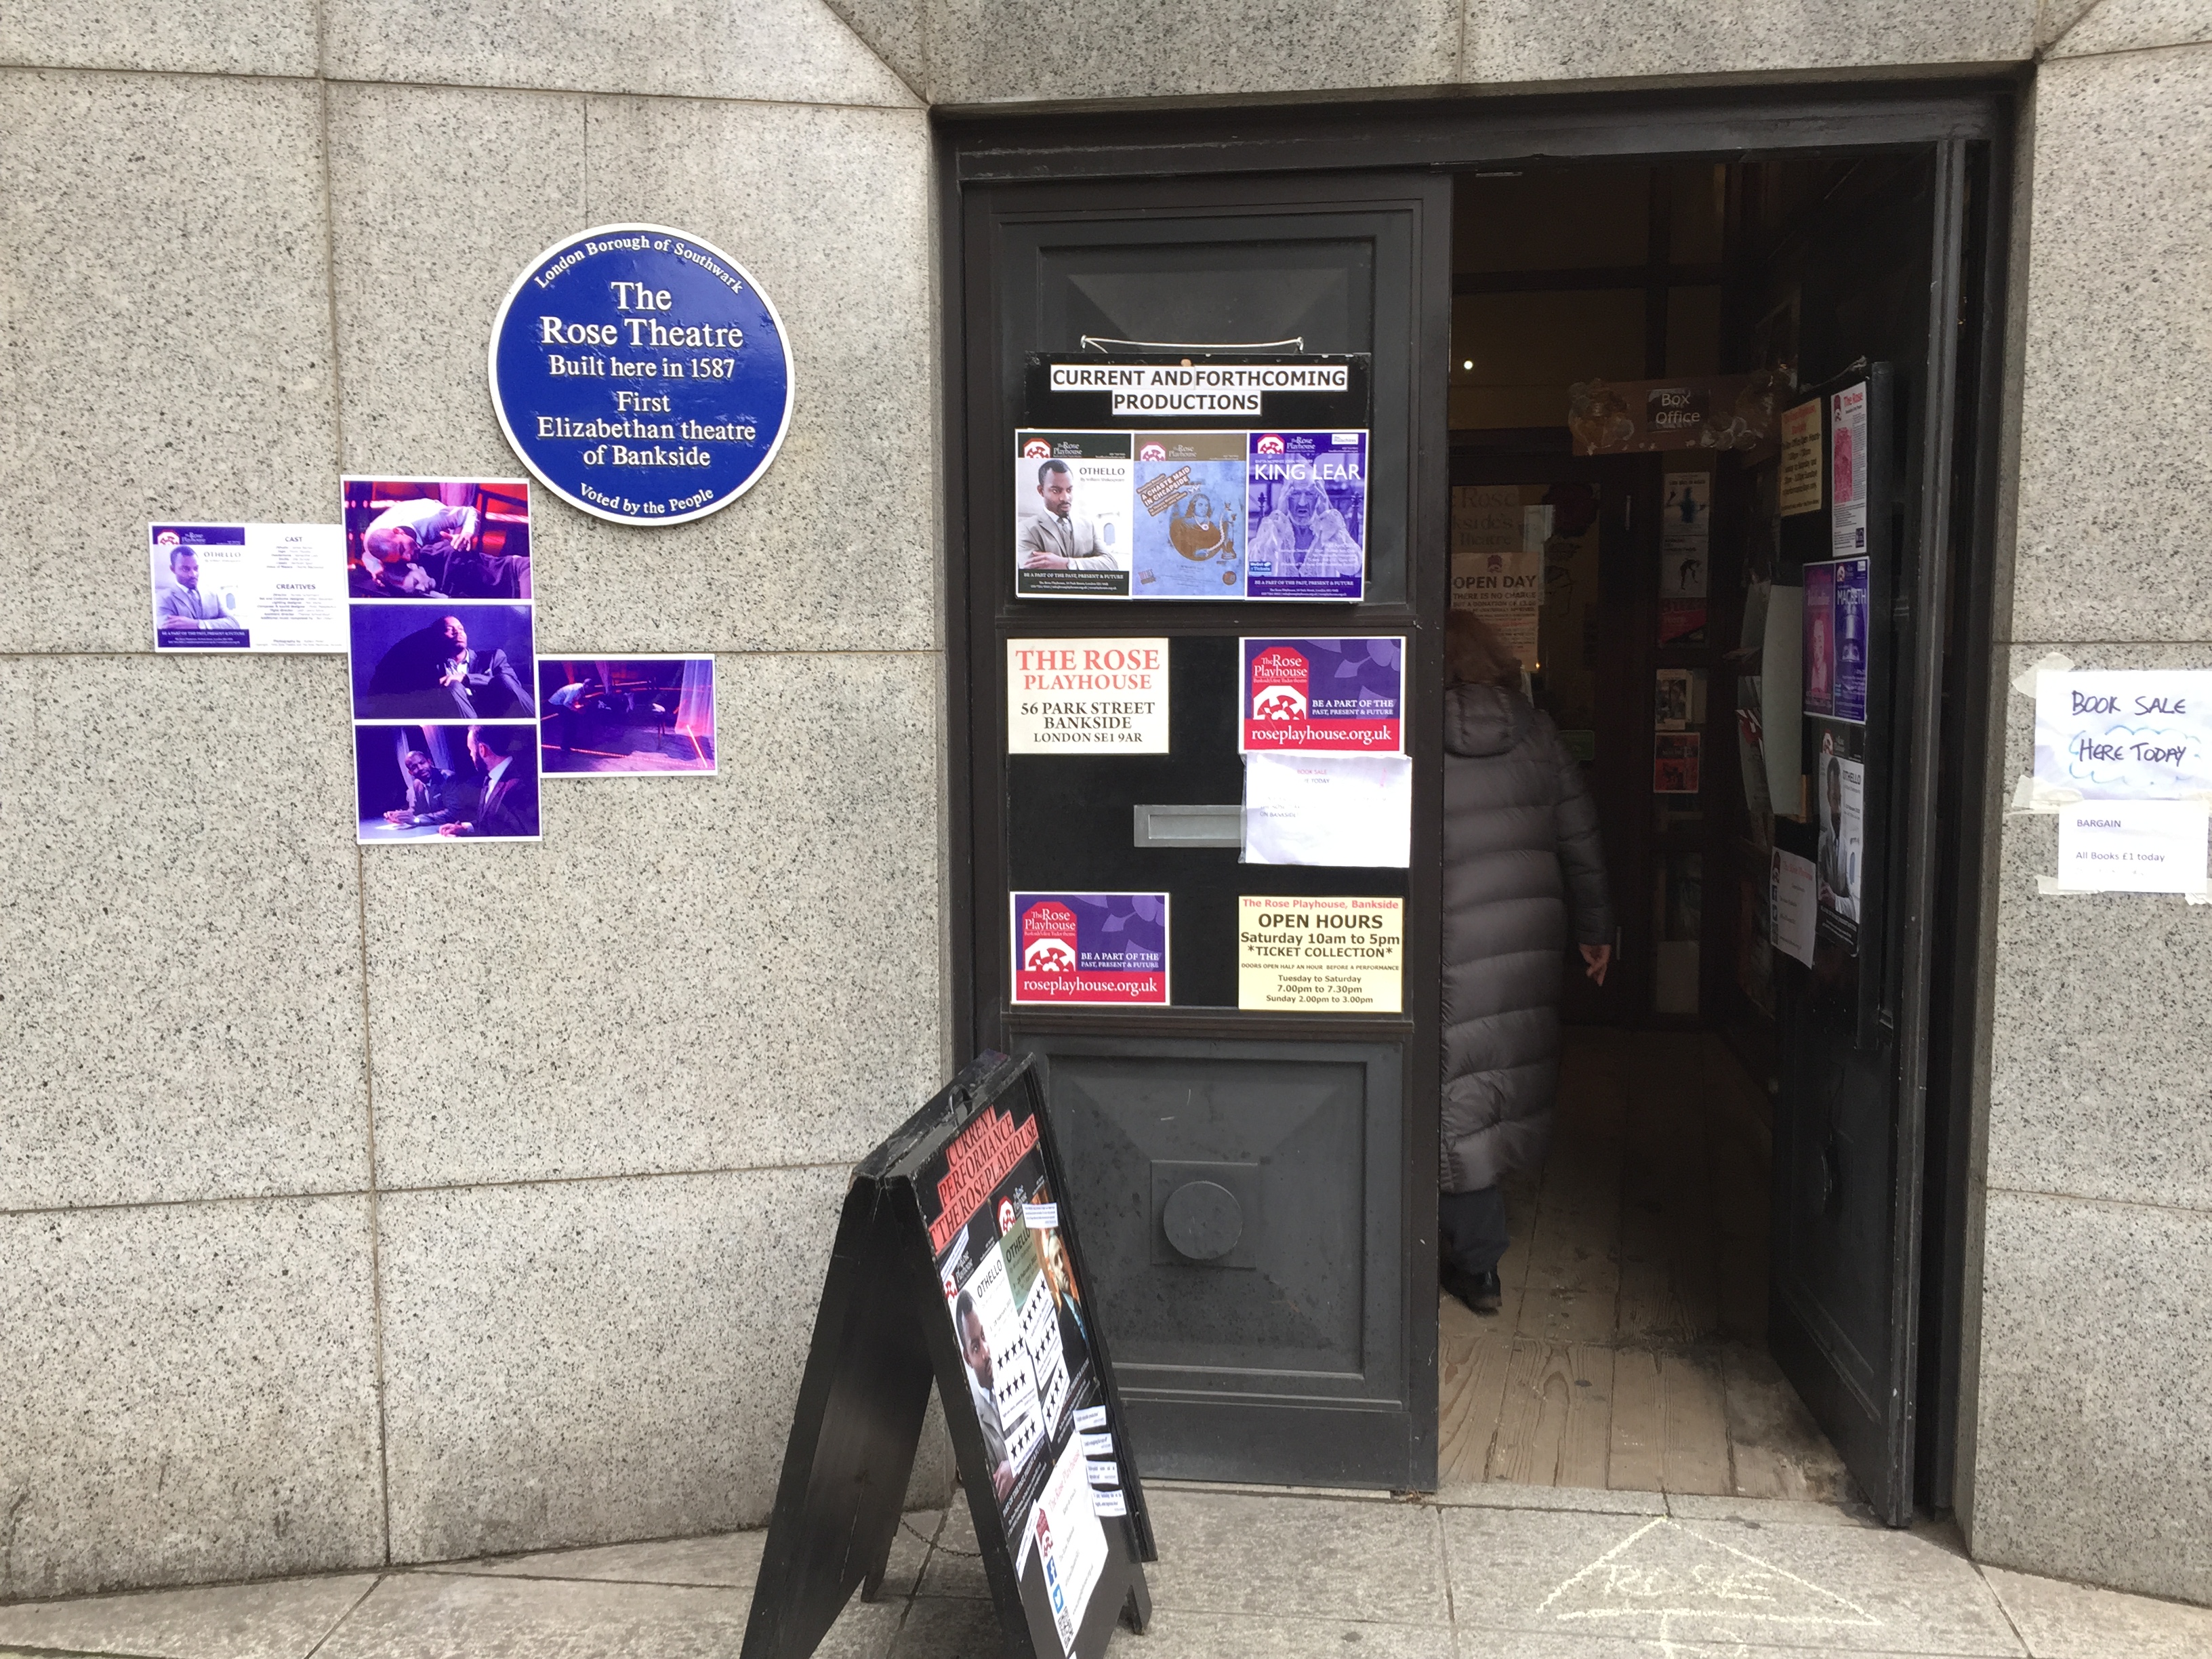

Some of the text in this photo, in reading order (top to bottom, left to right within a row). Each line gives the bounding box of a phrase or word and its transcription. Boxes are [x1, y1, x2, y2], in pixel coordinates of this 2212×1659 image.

[534, 236, 743, 293] London Borough of Southwark
[611, 282, 672, 310] The
[540, 316, 743, 347] Rose Theatre
[549, 355, 735, 379] Built here in 1587
[1052, 369, 1346, 387] CURRENT AND FORTHCOMING
[617, 392, 671, 412] First
[1113, 394, 1259, 410] PRODUCTIONS
[1662, 393, 1691, 406] Box
[1656, 411, 1700, 424] Office
[537, 417, 756, 440] Elizabethan theatre
[583, 445, 711, 466] of Bankside
[1080, 467, 1125, 475] OTHELLO
[1255, 464, 1361, 480] KING LEAR
[1147, 478, 1173, 495] CHASTE
[1172, 467, 1190, 480] MAID
[579, 483, 714, 515] Voted by the People
[1144, 497, 1153, 506] IN
[1153, 476, 1189, 501] CHEAPSIDE
[1453, 575, 1538, 589] OPEN DAY
[1837, 588, 1866, 605] MACBETH
[1015, 649, 1160, 670] THE ROSE
[1273, 654, 1302, 667] Rose
[1254, 665, 1308, 677] Playhouse
[1023, 674, 1152, 690] PLAYHOUSE
[1021, 702, 1155, 715] 56 PARK STREET
[1312, 699, 1324, 708] BE
[1334, 699, 1357, 708] PART
[1359, 699, 1372, 708] OF
[1374, 699, 1393, 708] THE
[2072, 690, 2186, 716] BOOK SALE
[1044, 716, 1132, 729] BANKSIDE
[1034, 733, 1143, 743] LONDON SE1 9AR
[1252, 724, 1391, 745] roseplayhouse.org.uk
[2078, 738, 2186, 766] HERE TODAY
[2076, 819, 2121, 828] BARGAIN
[2075, 852, 2165, 863] All Books £1 today
[1243, 899, 1399, 909] The Rose Playhouse, Bankside
[1042, 908, 1070, 920] Rose
[1258, 914, 1383, 928] OPEN HOURS
[1025, 919, 1076, 930] Playhouse
[1241, 932, 1400, 947] Saturday 10am to 5pm
[1081, 952, 1092, 960] BE
[1140, 953, 1159, 961] THE
[1023, 977, 1158, 997] roseplayhouse.org.uk
[1278, 975, 1312, 983] Tuesday
[1324, 975, 1361, 983] Saturday
[1277, 985, 1312, 994] 7.00pm
[1328, 985, 1362, 994] 7.30pm
[1266, 995, 1296, 1003] Sunday
[1343, 996, 1373, 1004] 3.00pm
[948, 1106, 996, 1167] CURRENT
[939, 1114, 1015, 1208] PERFORMANCE
[937, 1211, 962, 1244] THE
[962, 1175, 987, 1219] ROSE
[984, 1118, 1037, 1190] PLAYHOUSE
[1006, 1229, 1031, 1263] OTHELLO
[977, 1259, 1003, 1298] OTHELLO
